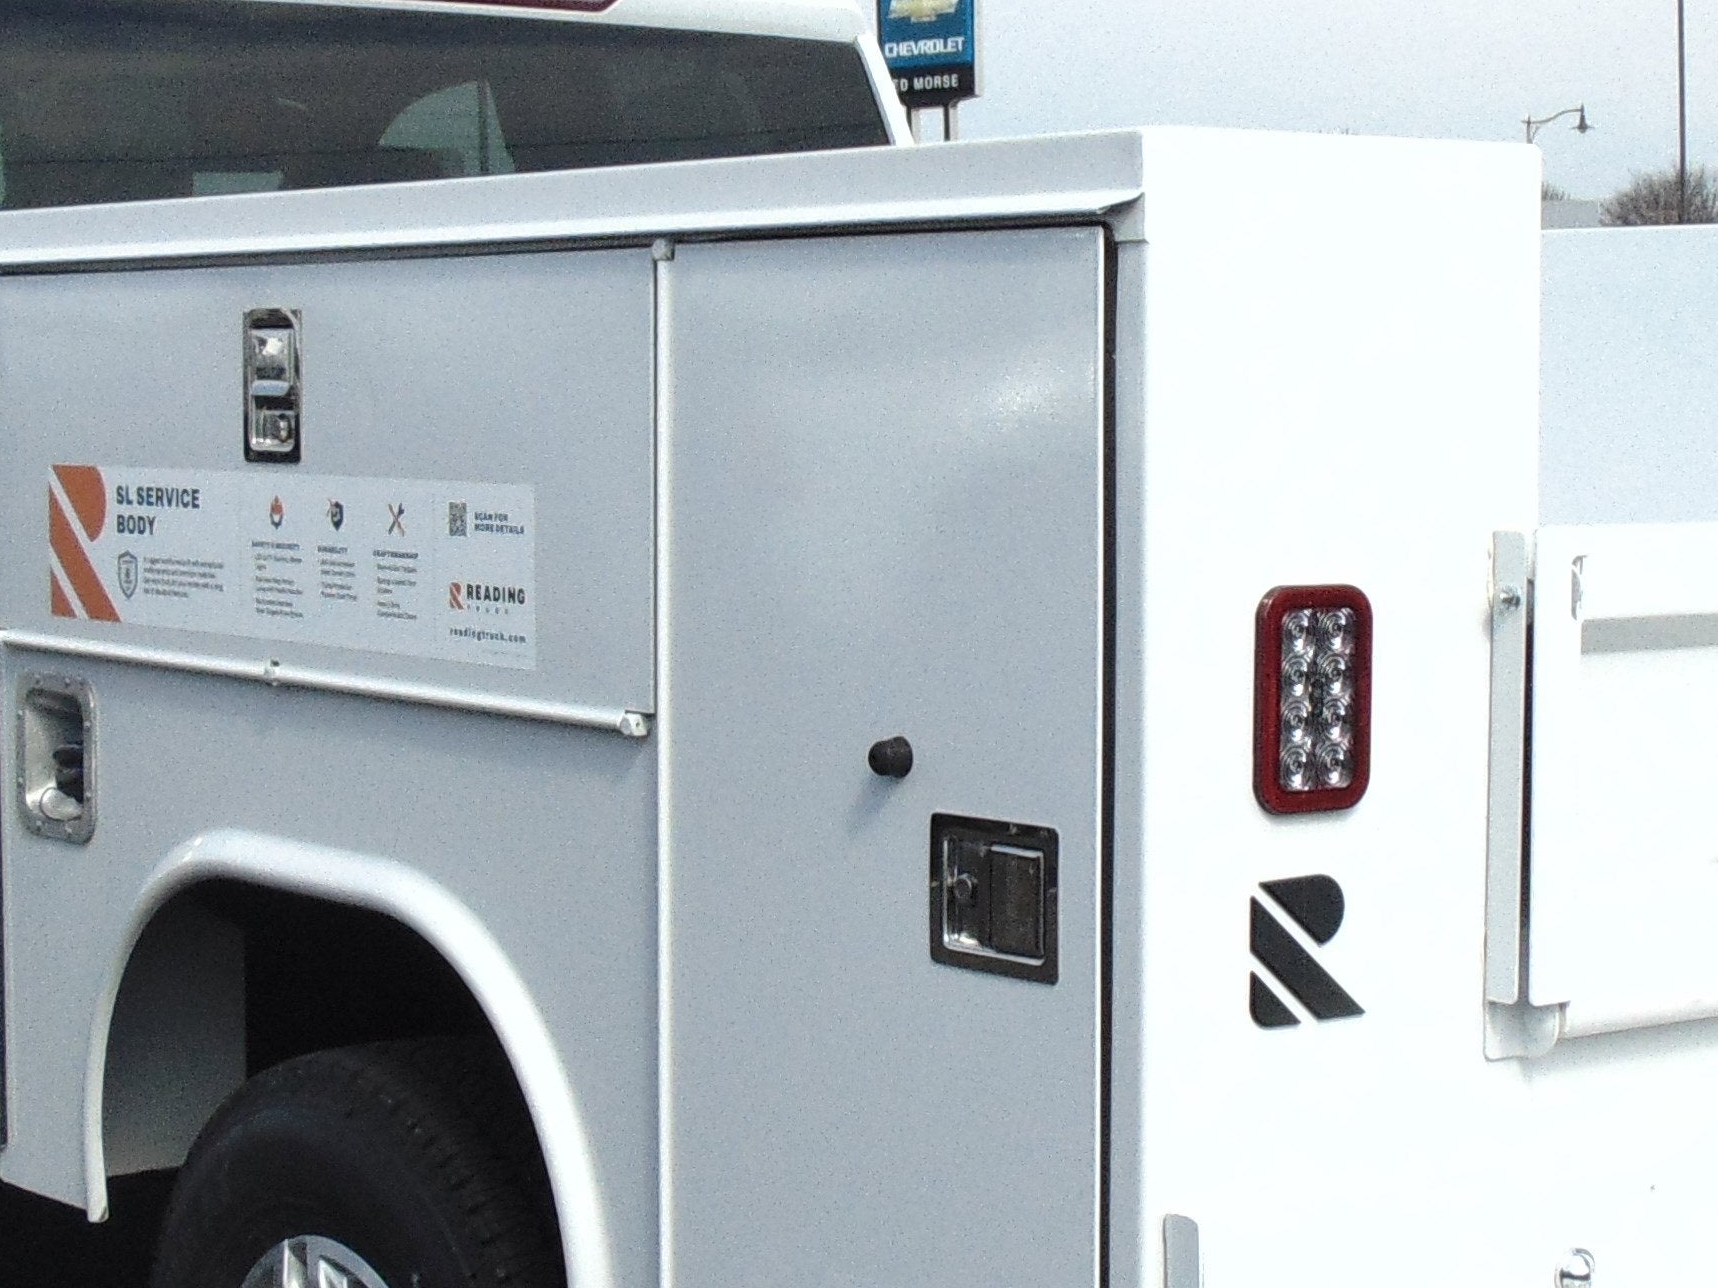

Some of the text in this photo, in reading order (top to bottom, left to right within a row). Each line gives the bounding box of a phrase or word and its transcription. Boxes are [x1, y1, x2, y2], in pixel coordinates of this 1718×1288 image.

[884, 37, 965, 58] CHEVROLET
[913, 73, 959, 90] MORSE
[116, 485, 200, 509] SL SERVICE
[116, 514, 156, 535] BODY
[466, 583, 526, 605] READING
